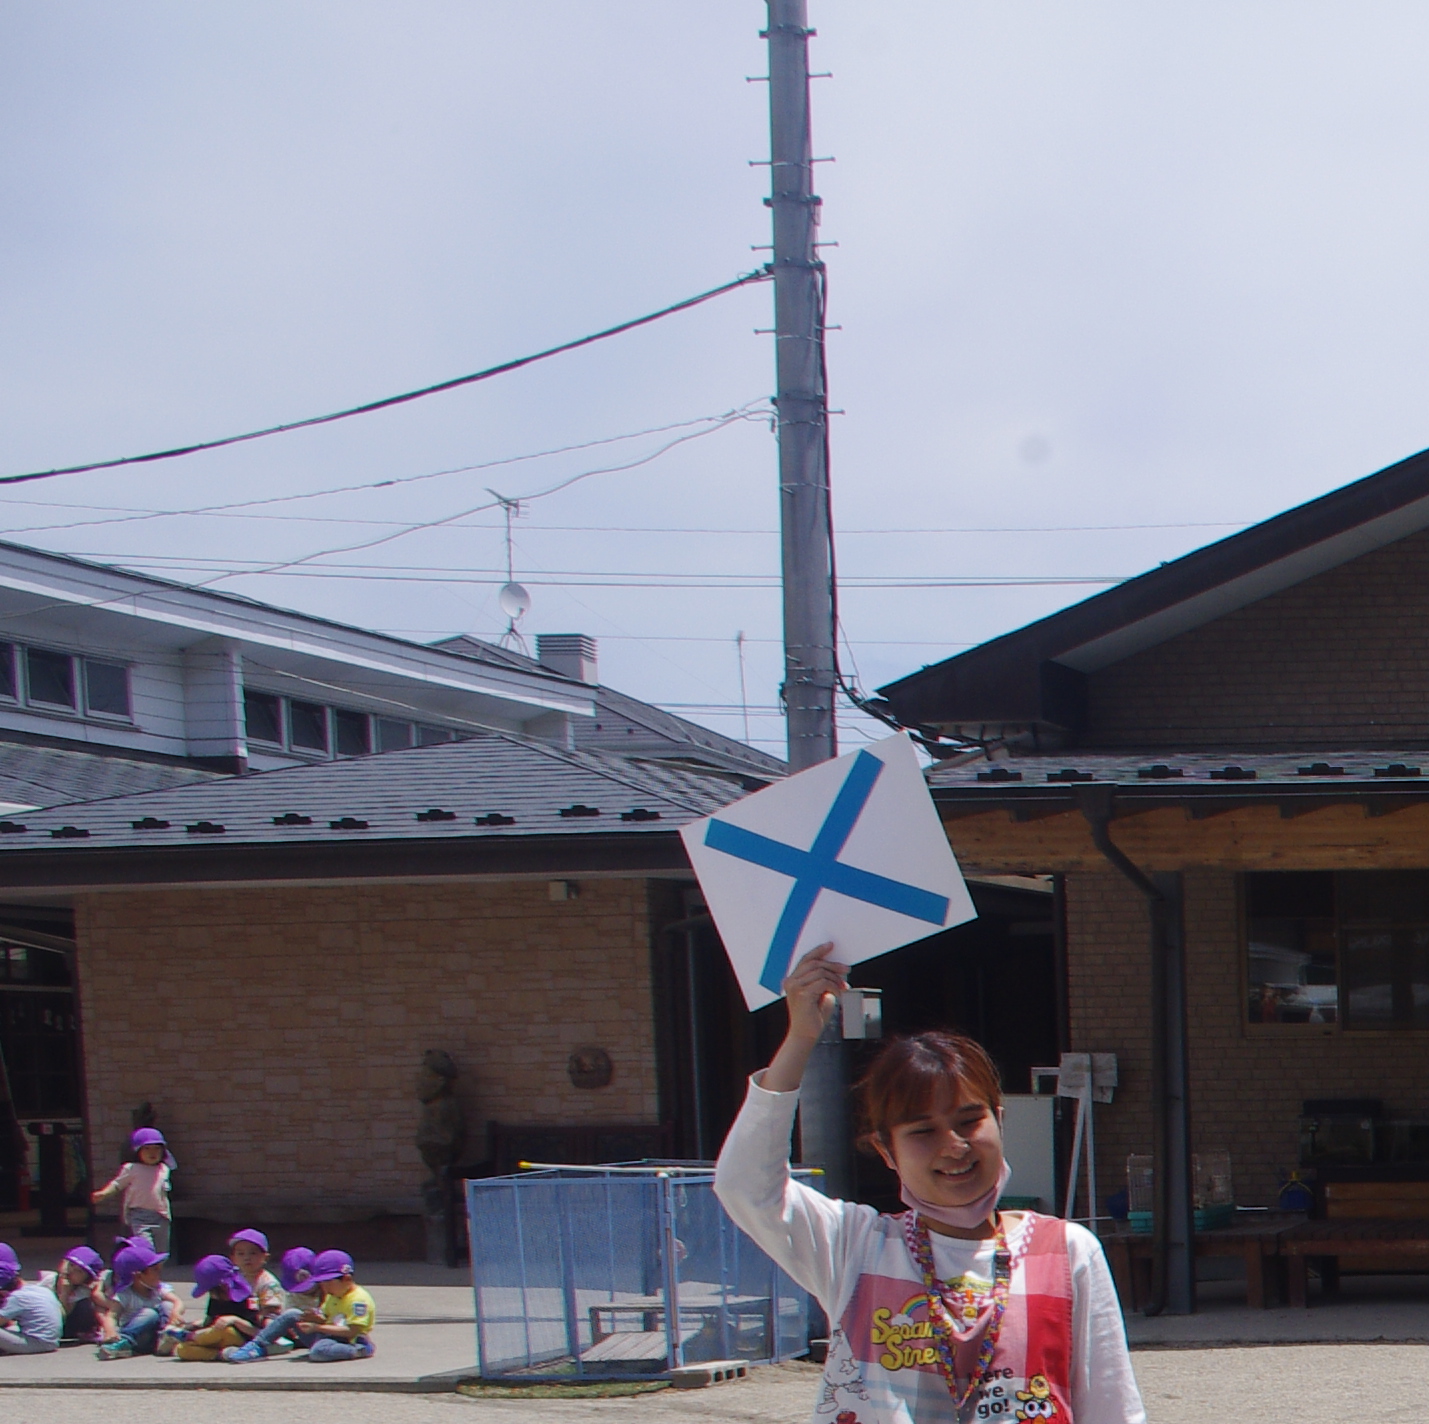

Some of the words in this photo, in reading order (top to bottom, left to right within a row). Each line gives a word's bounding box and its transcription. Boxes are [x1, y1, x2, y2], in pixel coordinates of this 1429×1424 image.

[871, 1307, 935, 1344] Sesa
[880, 1333, 942, 1371] Stre
[978, 1386, 1004, 1399] we
[977, 1399, 1010, 1419] go!
